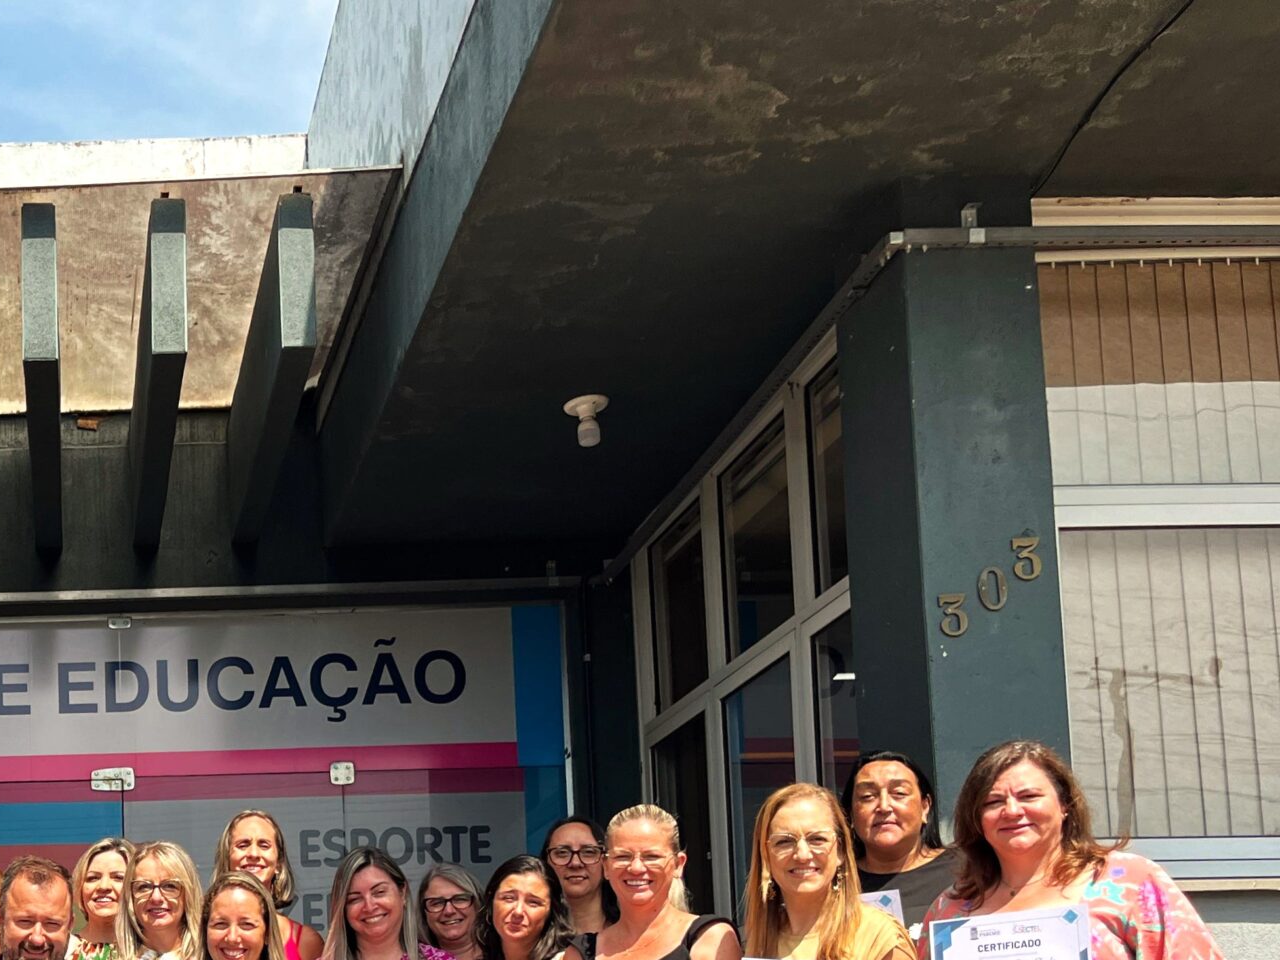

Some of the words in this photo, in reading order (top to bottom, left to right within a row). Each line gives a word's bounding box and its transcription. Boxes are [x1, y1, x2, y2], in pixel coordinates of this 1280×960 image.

[937, 536, 1042, 637] 303
[57, 637, 468, 723] EDUCAÇÃO
[299, 825, 492, 868] ESPORTE
[977, 938, 1042, 953] CERTIFICADO
